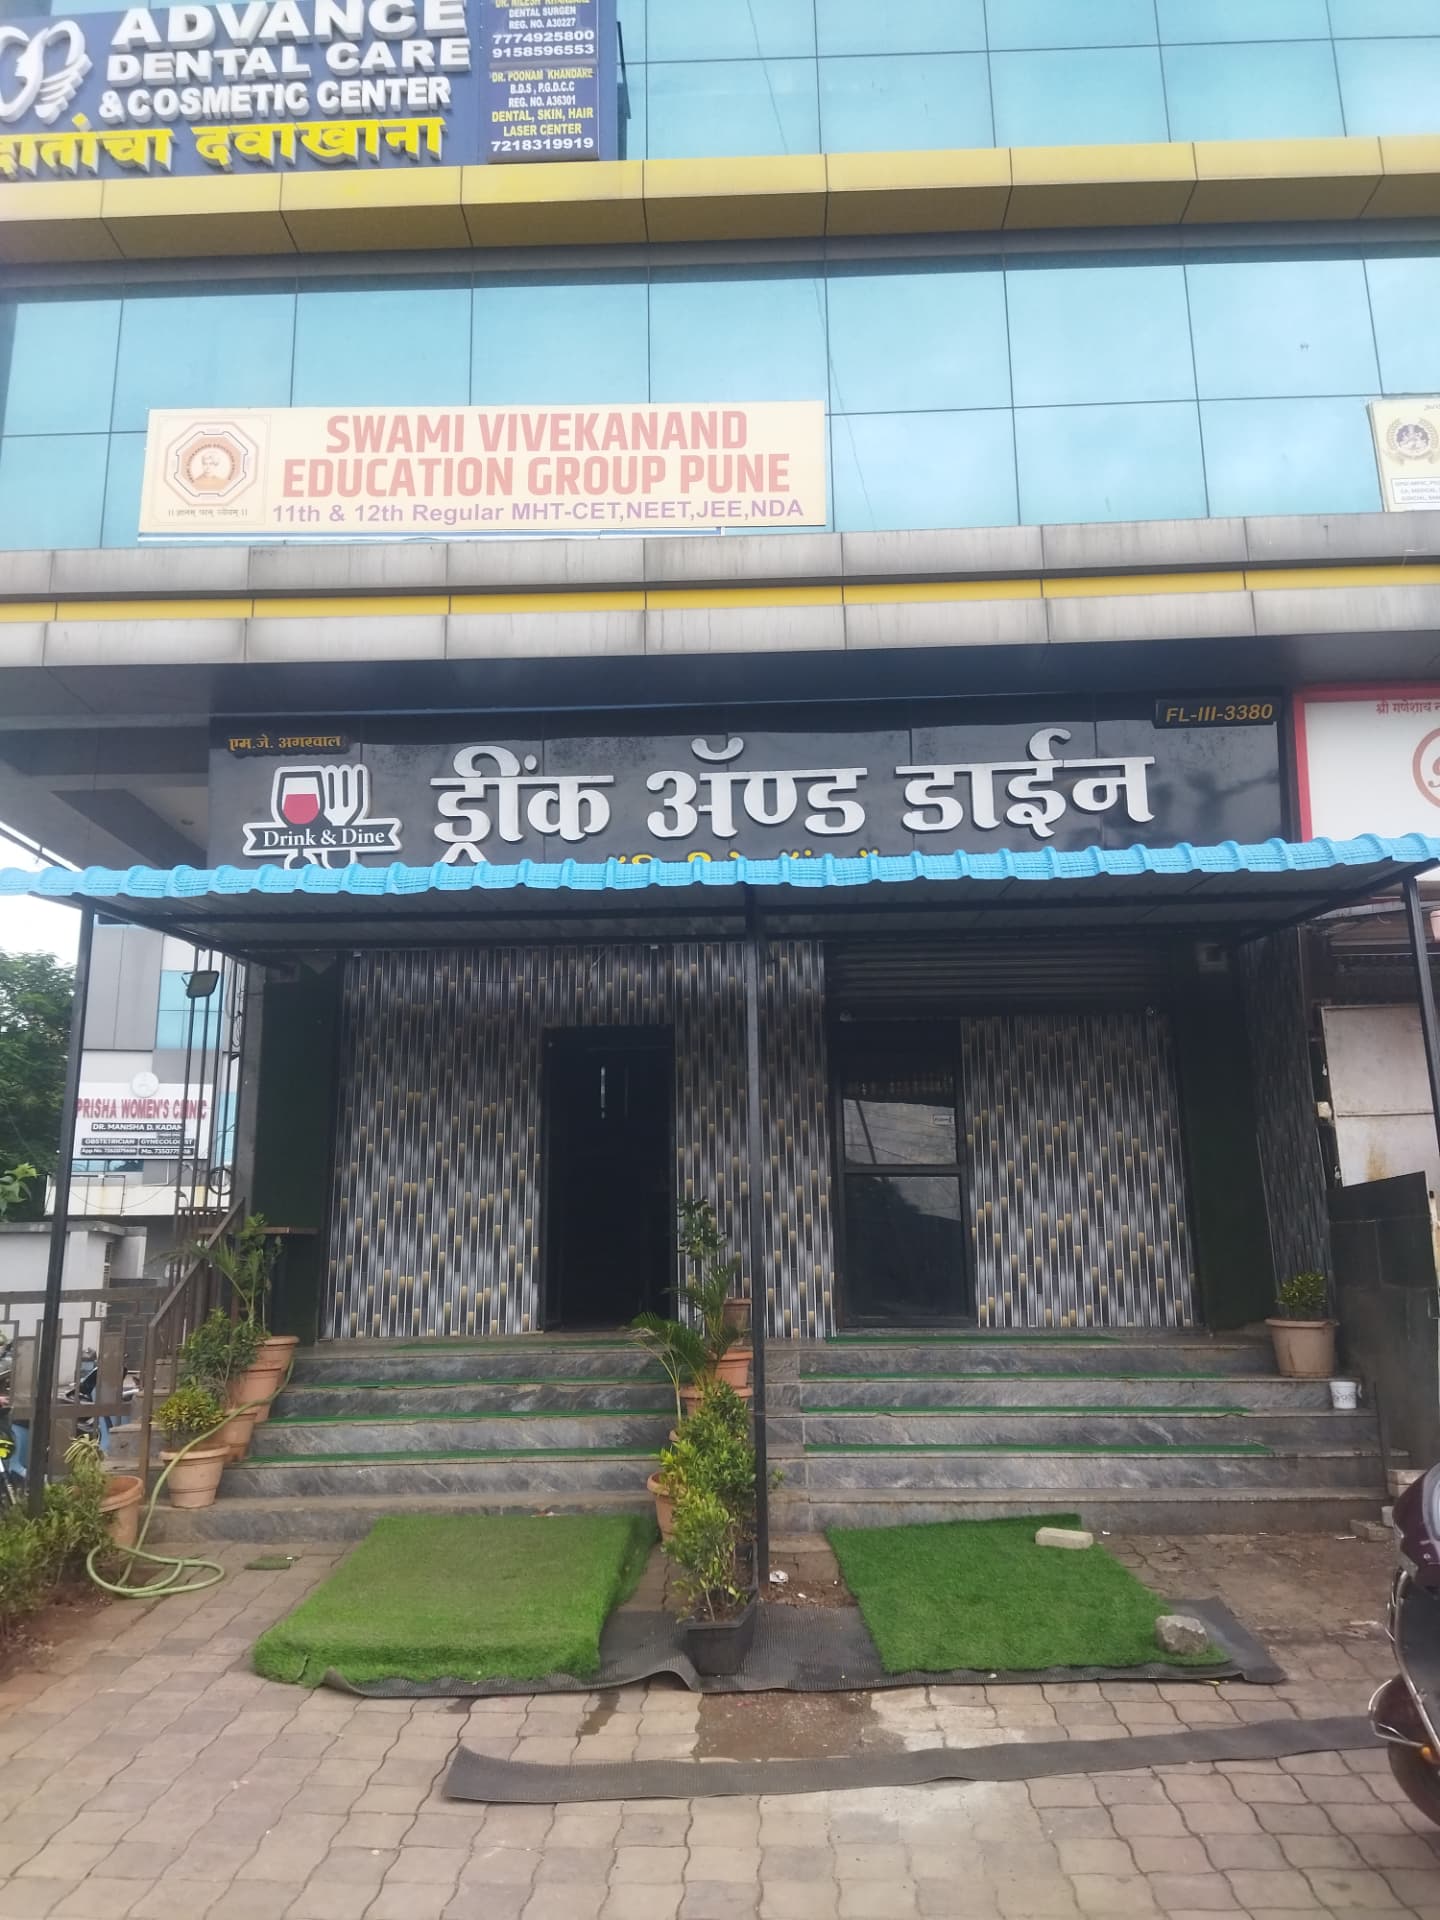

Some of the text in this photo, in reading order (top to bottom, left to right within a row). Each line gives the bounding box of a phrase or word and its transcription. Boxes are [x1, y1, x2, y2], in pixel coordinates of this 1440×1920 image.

[509, 7, 541, 18] DENTAL
[111, 0, 467, 50] ADVANCE
[509, 19, 528, 29] REG.
[530, 19, 544, 28] NO.
[492, 30, 594, 44] 7774925800
[492, 44, 594, 58] 9158596553
[107, 38, 471, 87] DENTAL CARE
[492, 71, 506, 83] DR.
[508, 69, 544, 82] POONAM
[317, 77, 451, 115] CENTER
[508, 94, 576, 108] REG. NO. A36301
[492, 107, 594, 122] DENTAL, SKIN, HAIR
[504, 123, 582, 137] LASER CENTER
[191, 117, 446, 173] दवाखाना
[491, 137, 594, 152] 7218319919
[326, 410, 747, 454] SWAMI VIVEKANAND
[282, 457, 513, 498] EDUCATION
[527, 454, 665, 496] GROUP
[680, 453, 790, 494] PUNE
[272, 504, 320, 522] 11th
[328, 504, 345, 522] &
[355, 503, 403, 521] 12th
[412, 502, 504, 526] Regular
[1165, 703, 1274, 723] FL-III-3380
[895, 728, 1156, 838] डाईन
[263, 828, 385, 847] Drink & Dine
[77, 1098, 117, 1119] PRISHA
[121, 1098, 170, 1119] WOMEN'S
